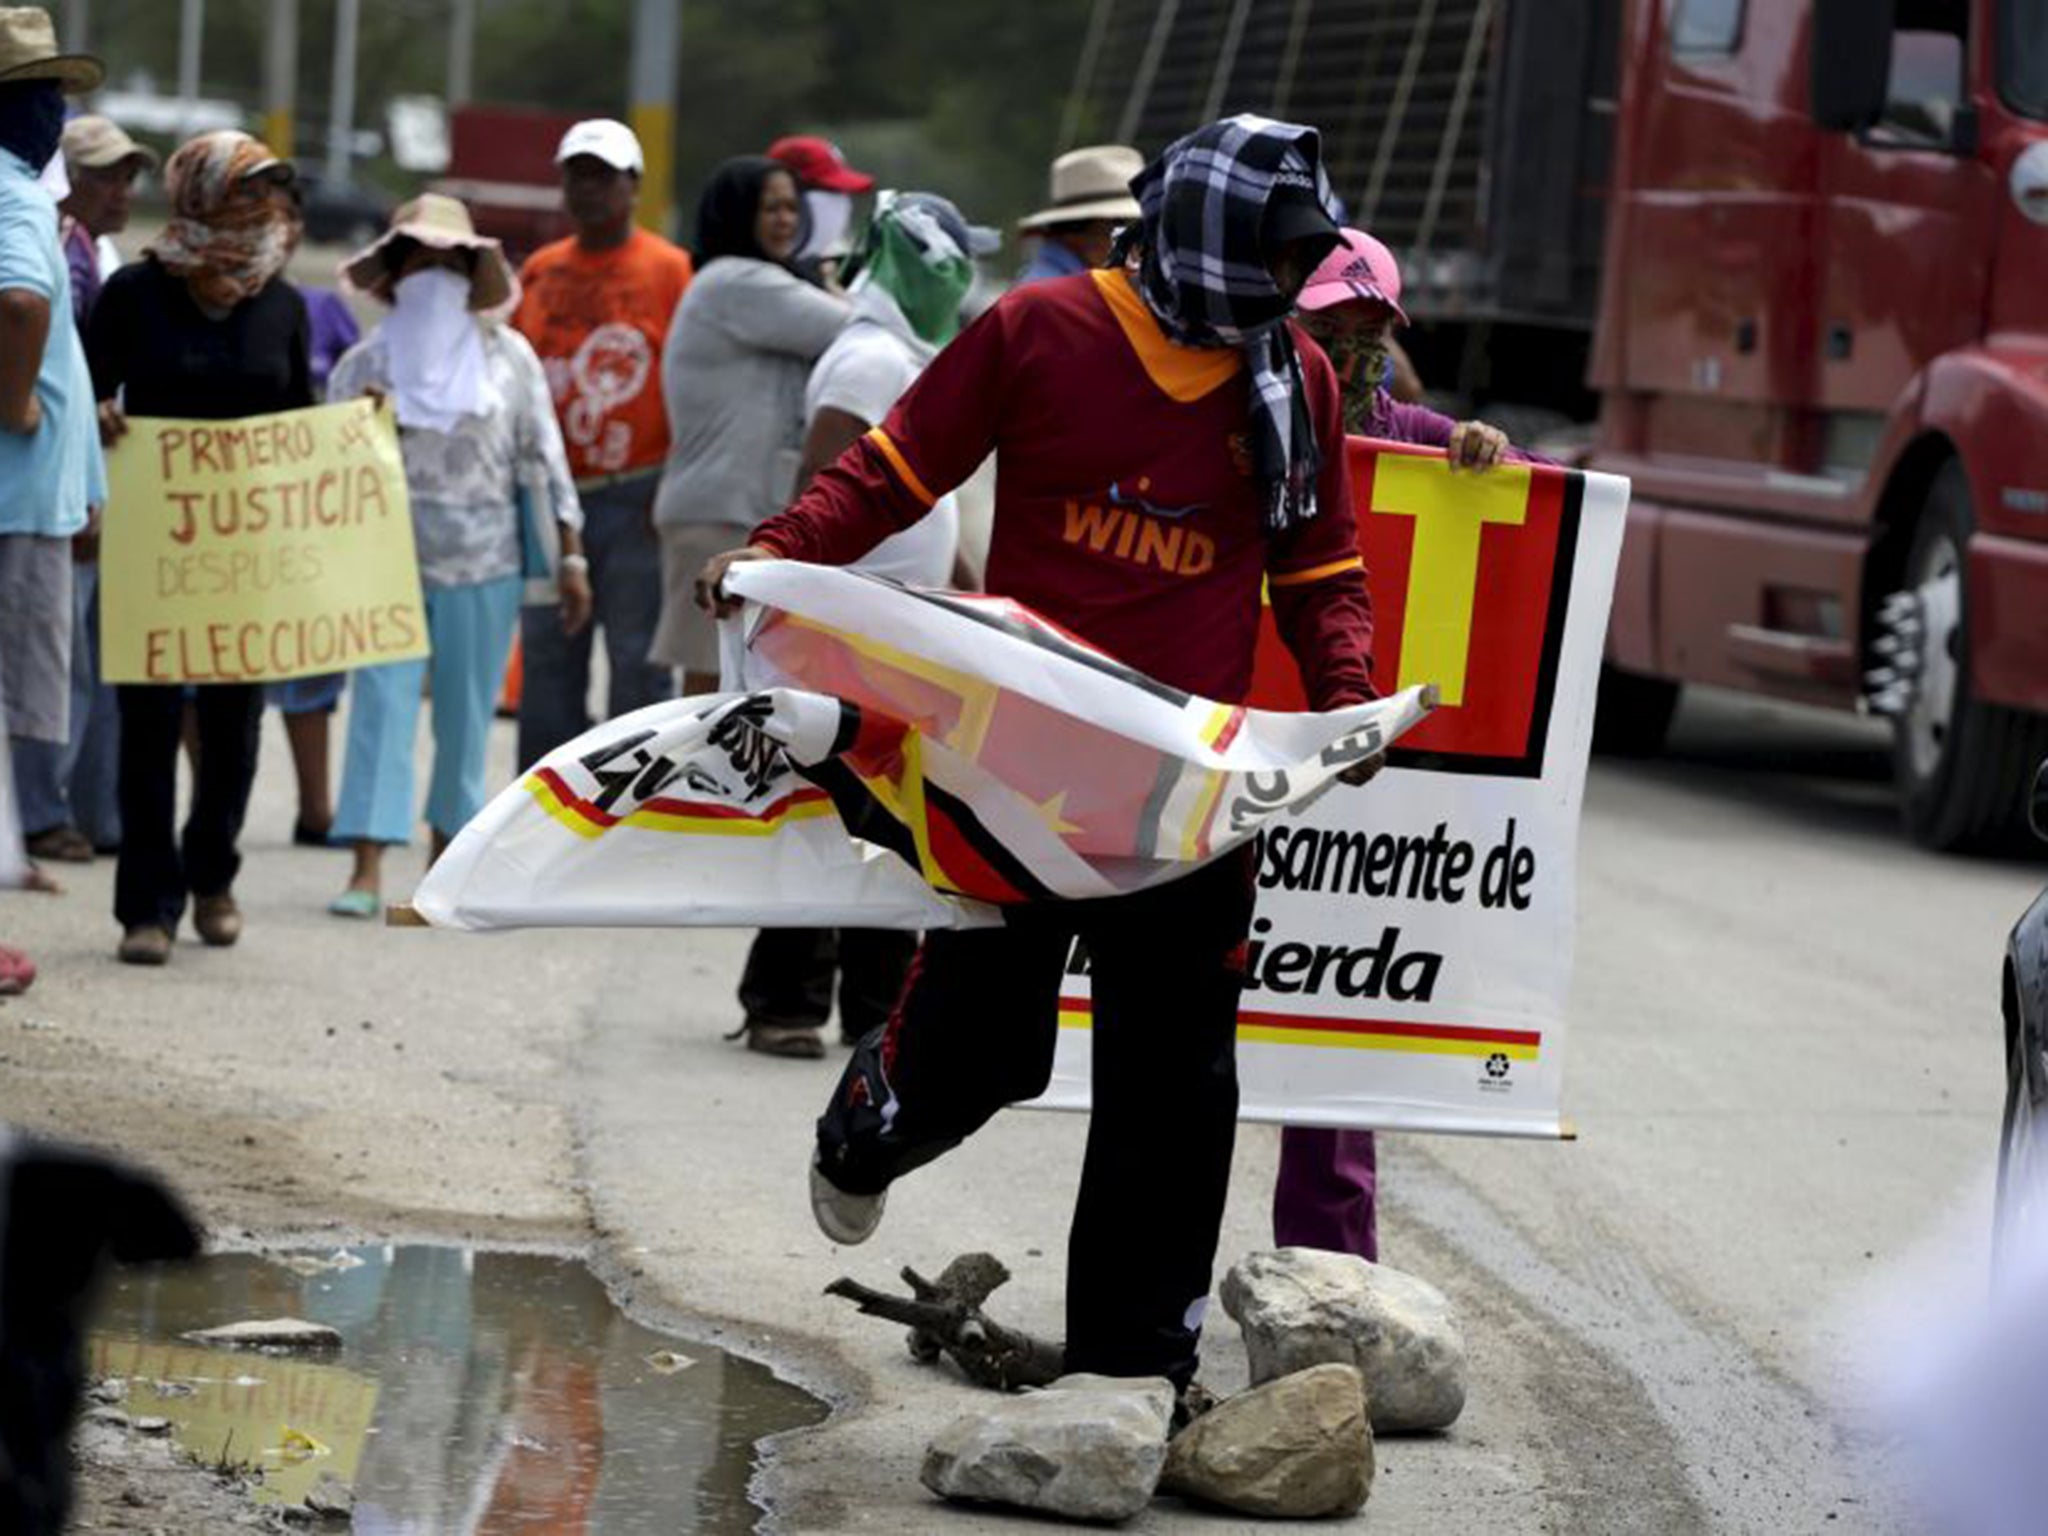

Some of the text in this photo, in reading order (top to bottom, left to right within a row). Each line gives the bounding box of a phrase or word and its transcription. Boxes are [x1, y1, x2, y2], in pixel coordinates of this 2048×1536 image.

[156, 420, 315, 482] PRIMERO
[165, 465, 388, 545] JUSTICIA
[1062, 499, 1215, 576] WIND
[156, 544, 323, 599] DESPUES
[1370, 450, 1533, 708] T
[145, 602, 419, 683] ELECCIONES
[1479, 817, 1535, 911] de
